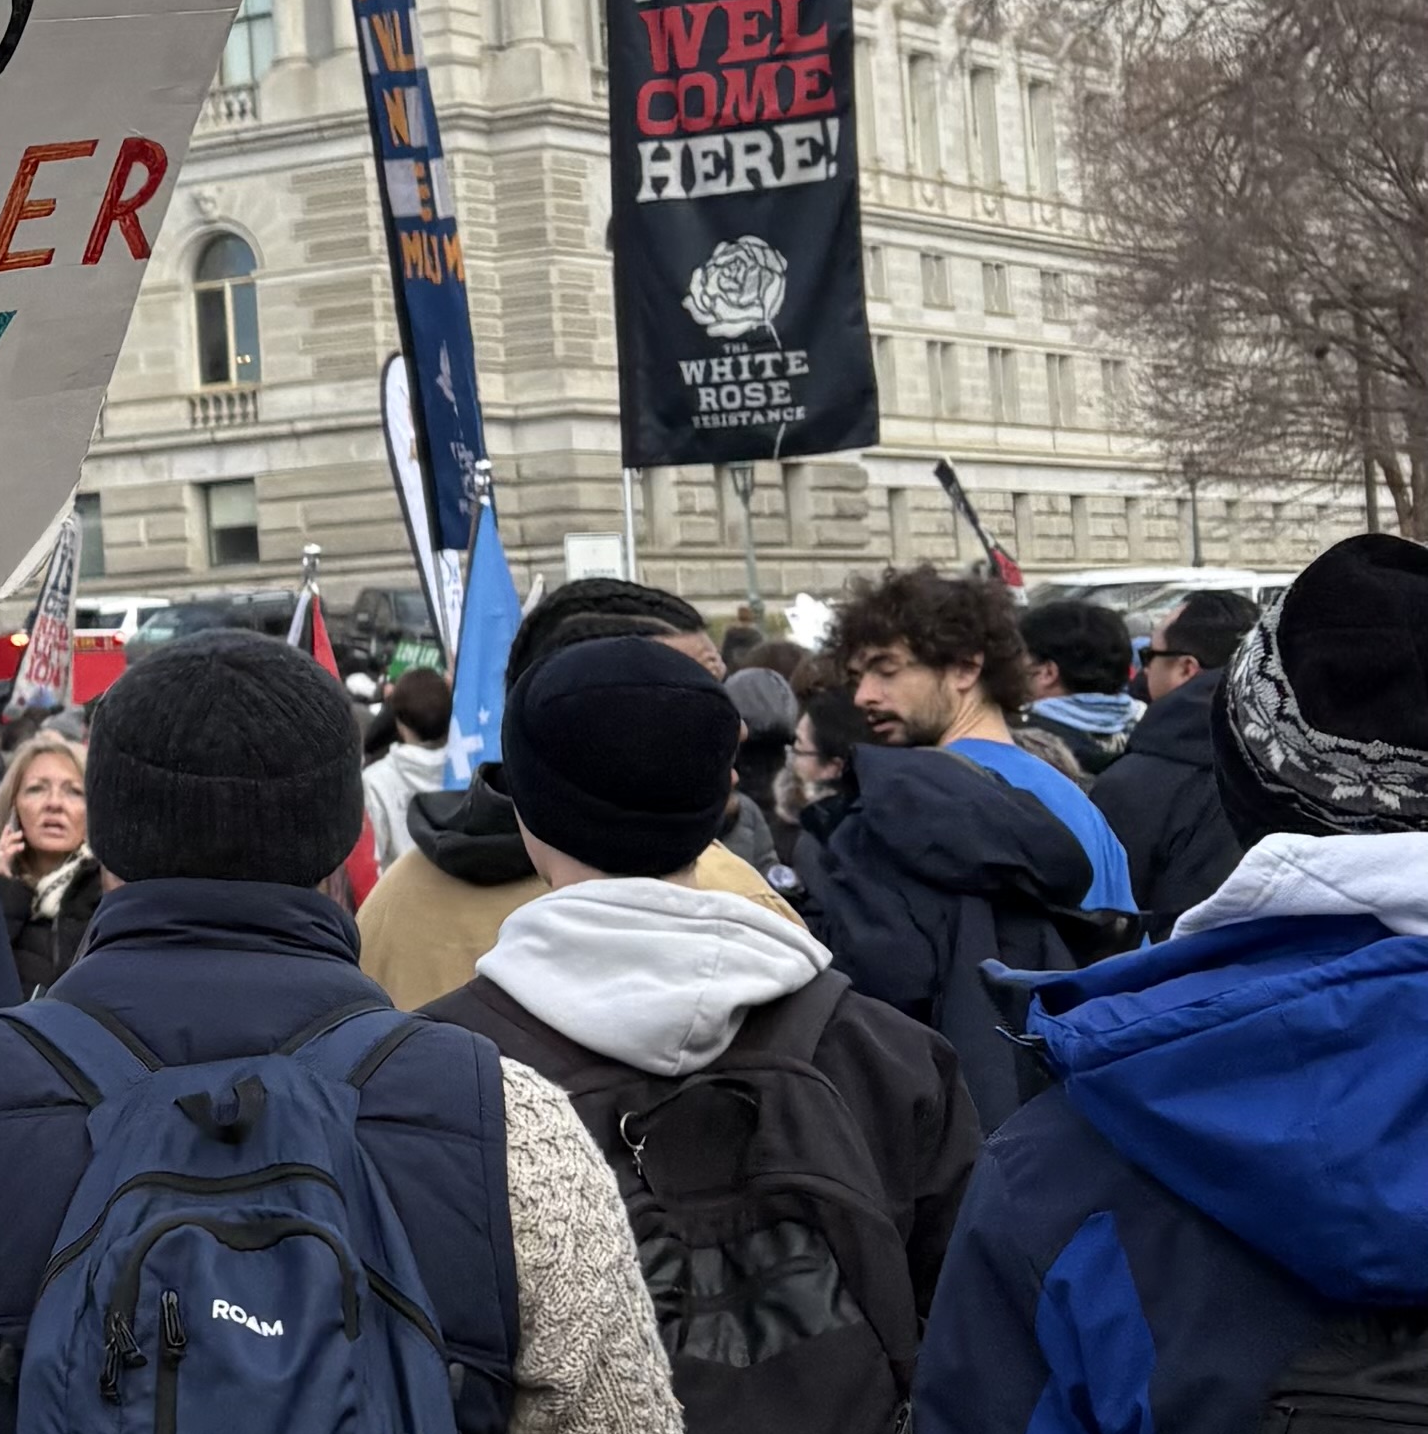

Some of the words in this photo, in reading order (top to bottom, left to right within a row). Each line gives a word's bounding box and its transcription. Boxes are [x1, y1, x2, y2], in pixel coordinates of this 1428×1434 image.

[637, 54, 836, 135] COME
[637, 118, 839, 202] HERE!
[678, 350, 809, 385] WHITE
[698, 380, 792, 412] ROSE
[691, 406, 806, 429] RESISTANCE
[212, 1299, 283, 1337] ROAM
